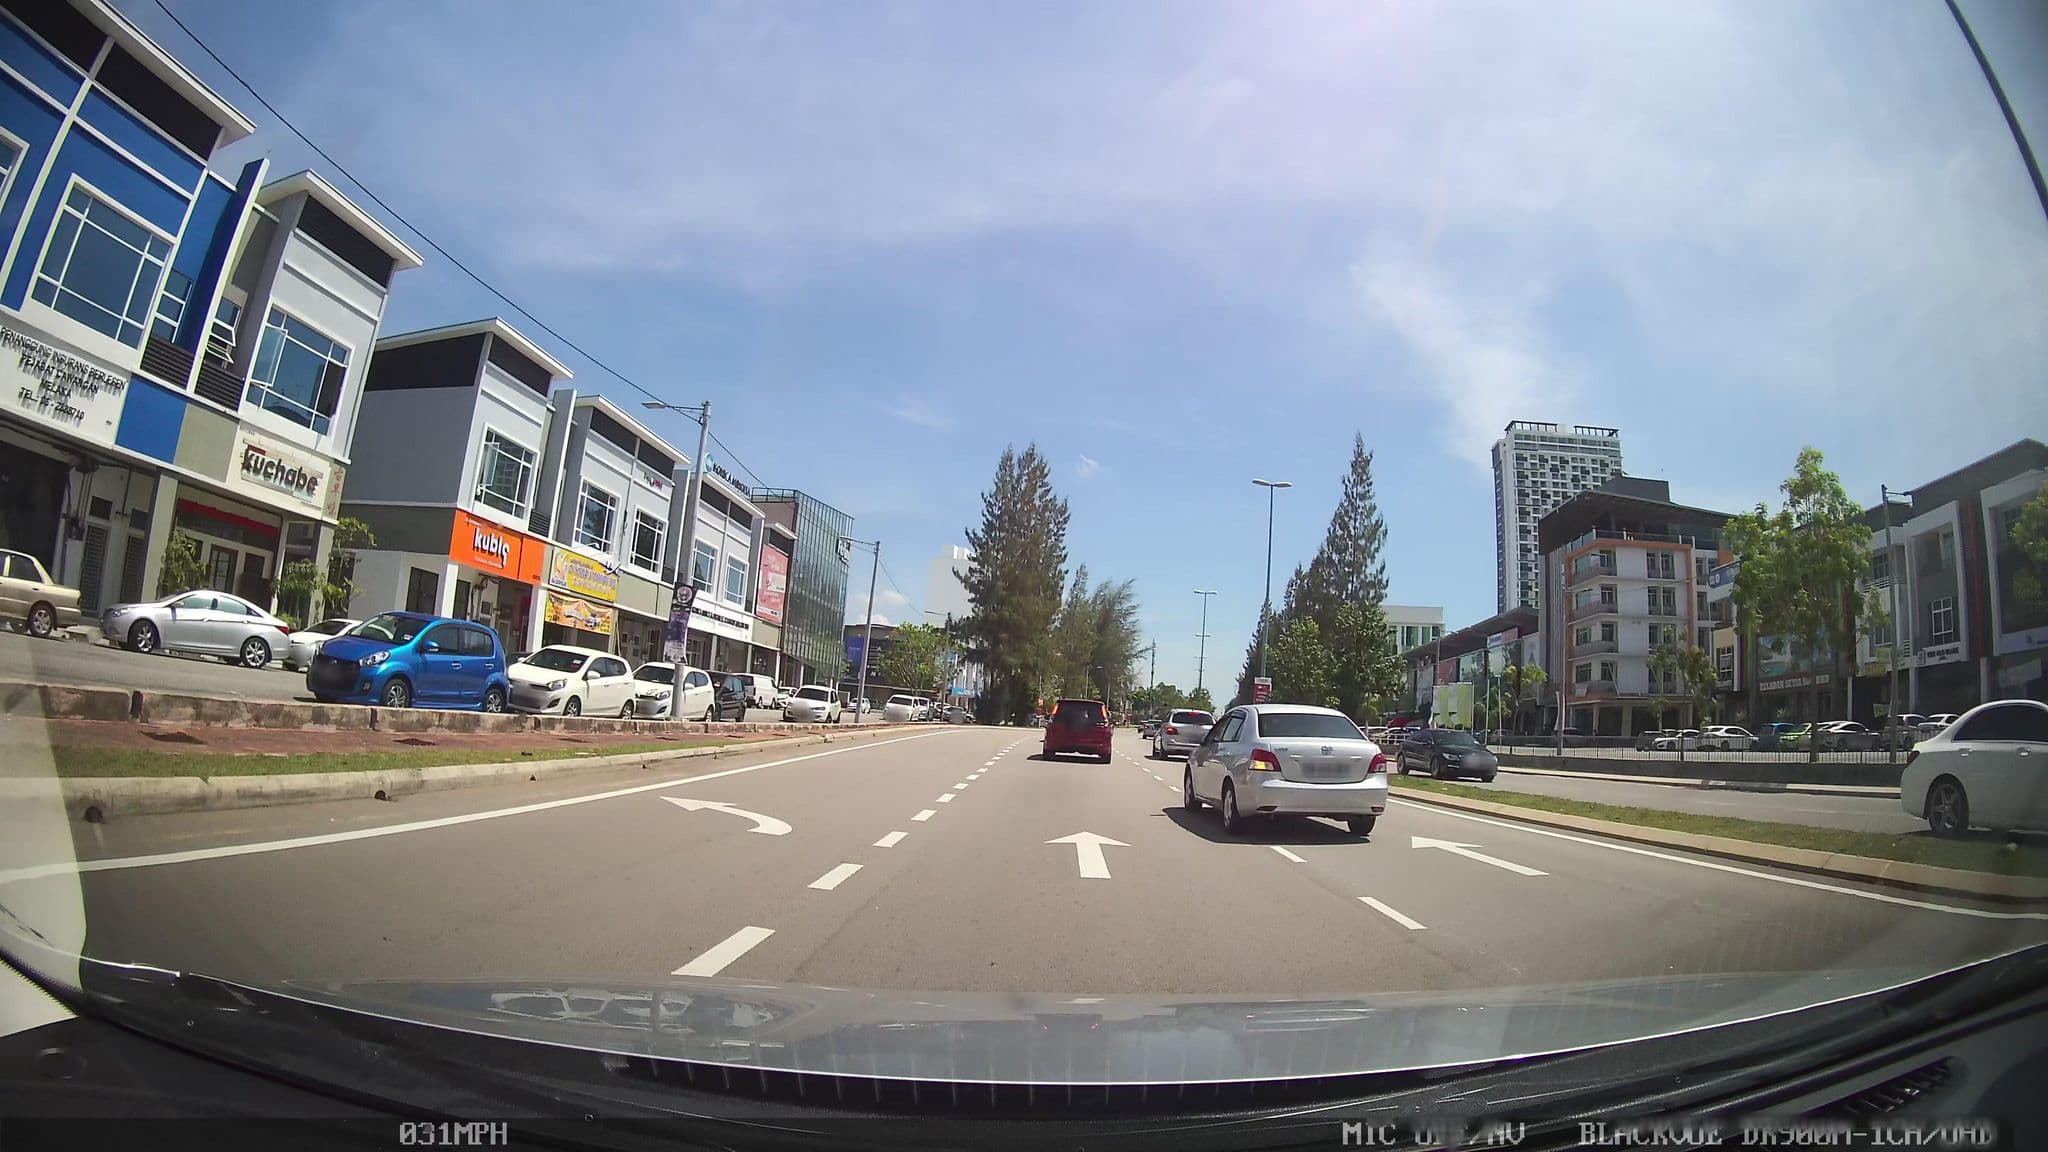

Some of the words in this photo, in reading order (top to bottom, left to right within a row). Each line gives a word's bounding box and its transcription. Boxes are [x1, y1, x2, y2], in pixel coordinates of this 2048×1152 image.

[1, 327, 52, 358] PENANGGUNG
[52, 350, 90, 375] INSURANS
[20, 353, 56, 377] PEJABAT
[56, 369, 100, 395] CAWANGAN
[40, 378, 72, 399] MELAKA
